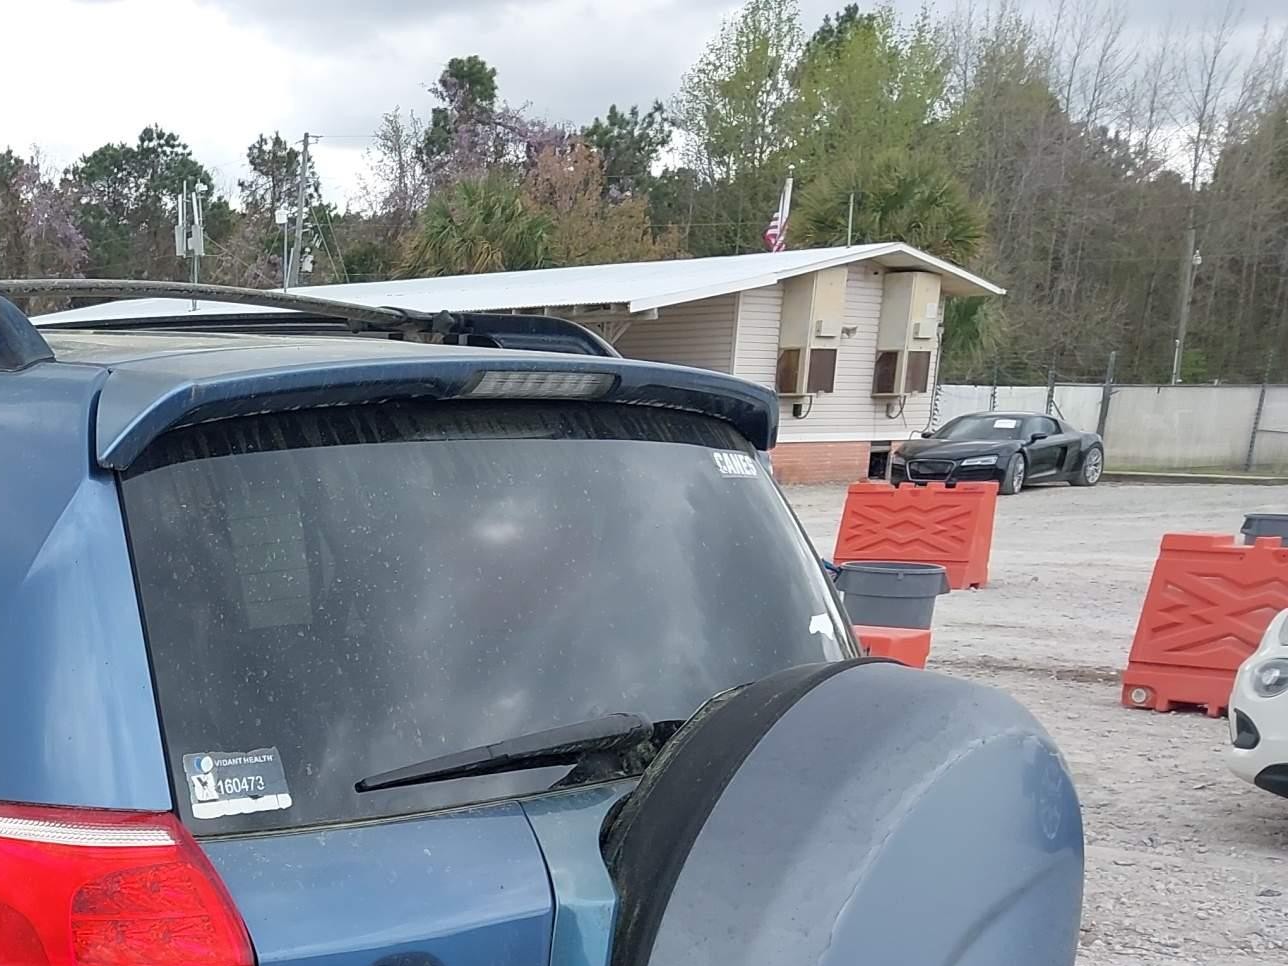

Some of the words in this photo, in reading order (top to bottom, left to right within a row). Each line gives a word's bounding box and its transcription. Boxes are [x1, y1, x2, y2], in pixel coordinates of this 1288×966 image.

[713, 452, 757, 475] CANES
[214, 757, 243, 766] VIDANT
[244, 754, 273, 764] HEALTH
[217, 775, 265, 795] 160473
